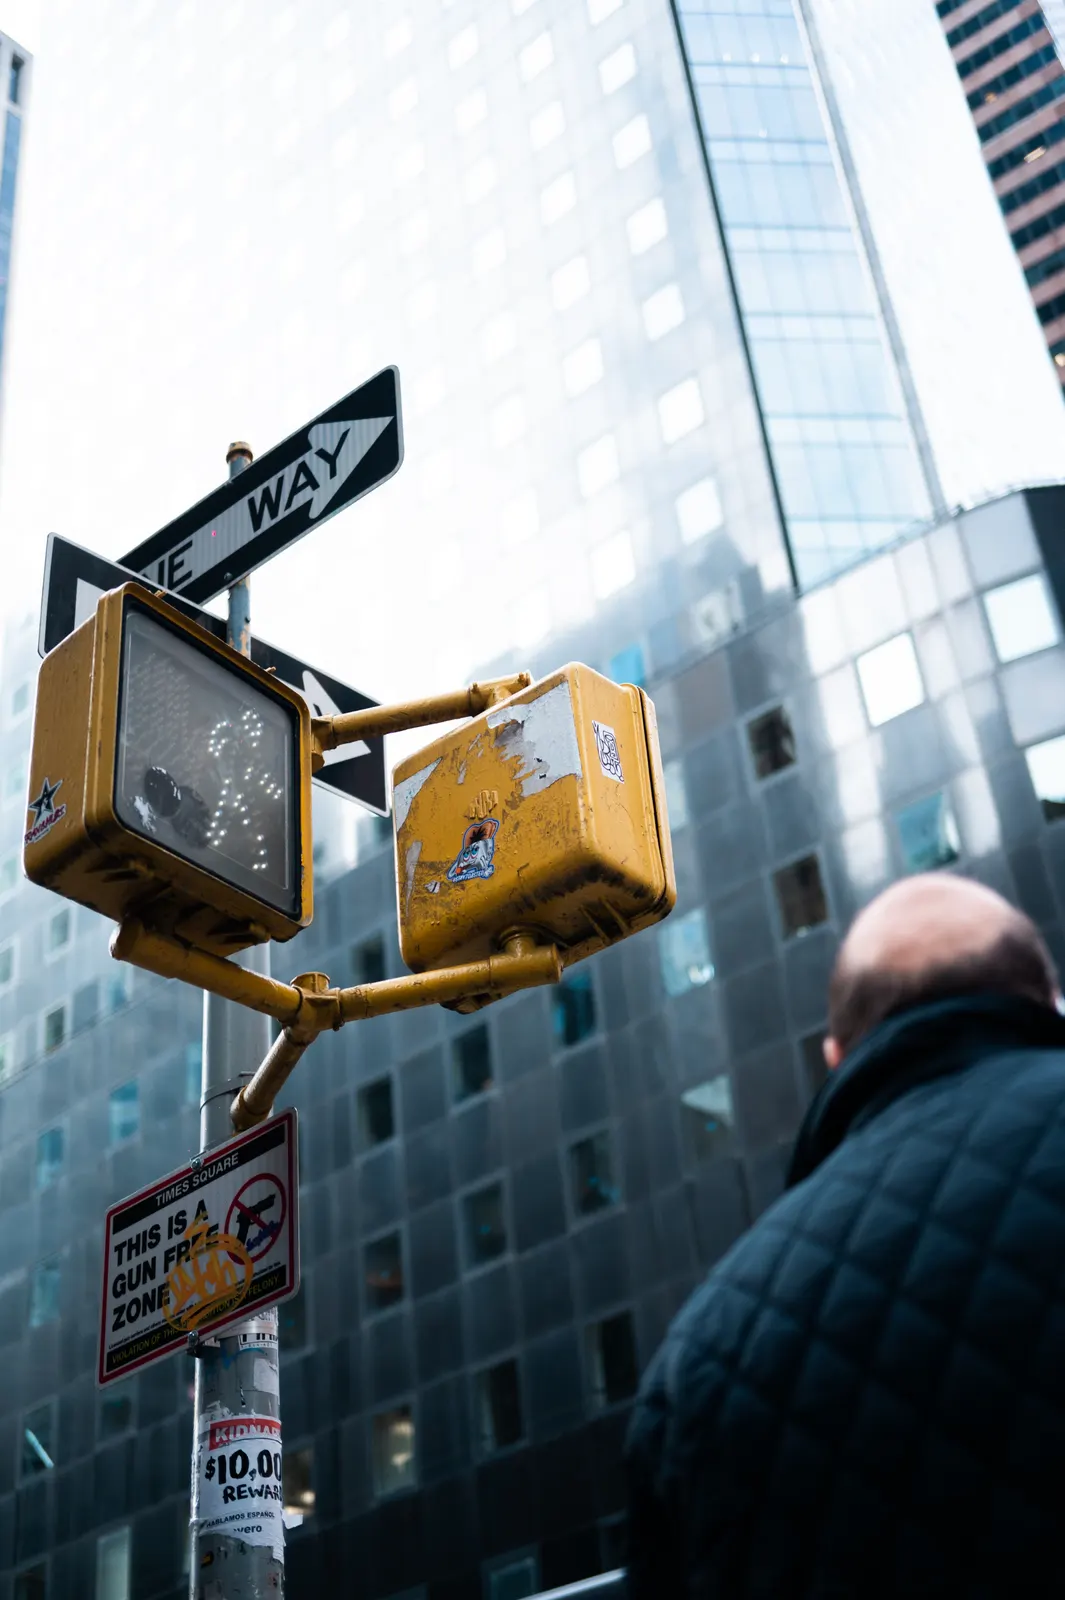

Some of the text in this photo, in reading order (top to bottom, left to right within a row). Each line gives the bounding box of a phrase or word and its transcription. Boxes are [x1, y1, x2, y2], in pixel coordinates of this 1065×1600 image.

[248, 428, 351, 533] WAY
[155, 1152, 240, 1206] TIMES SQUARE
[114, 1199, 209, 1267] THIS IS A
[112, 1256, 156, 1299] GUN
[112, 1281, 170, 1332] ZONE
[112, 1339, 150, 1364] VIOLATION
[151, 1332, 162, 1345] OF
